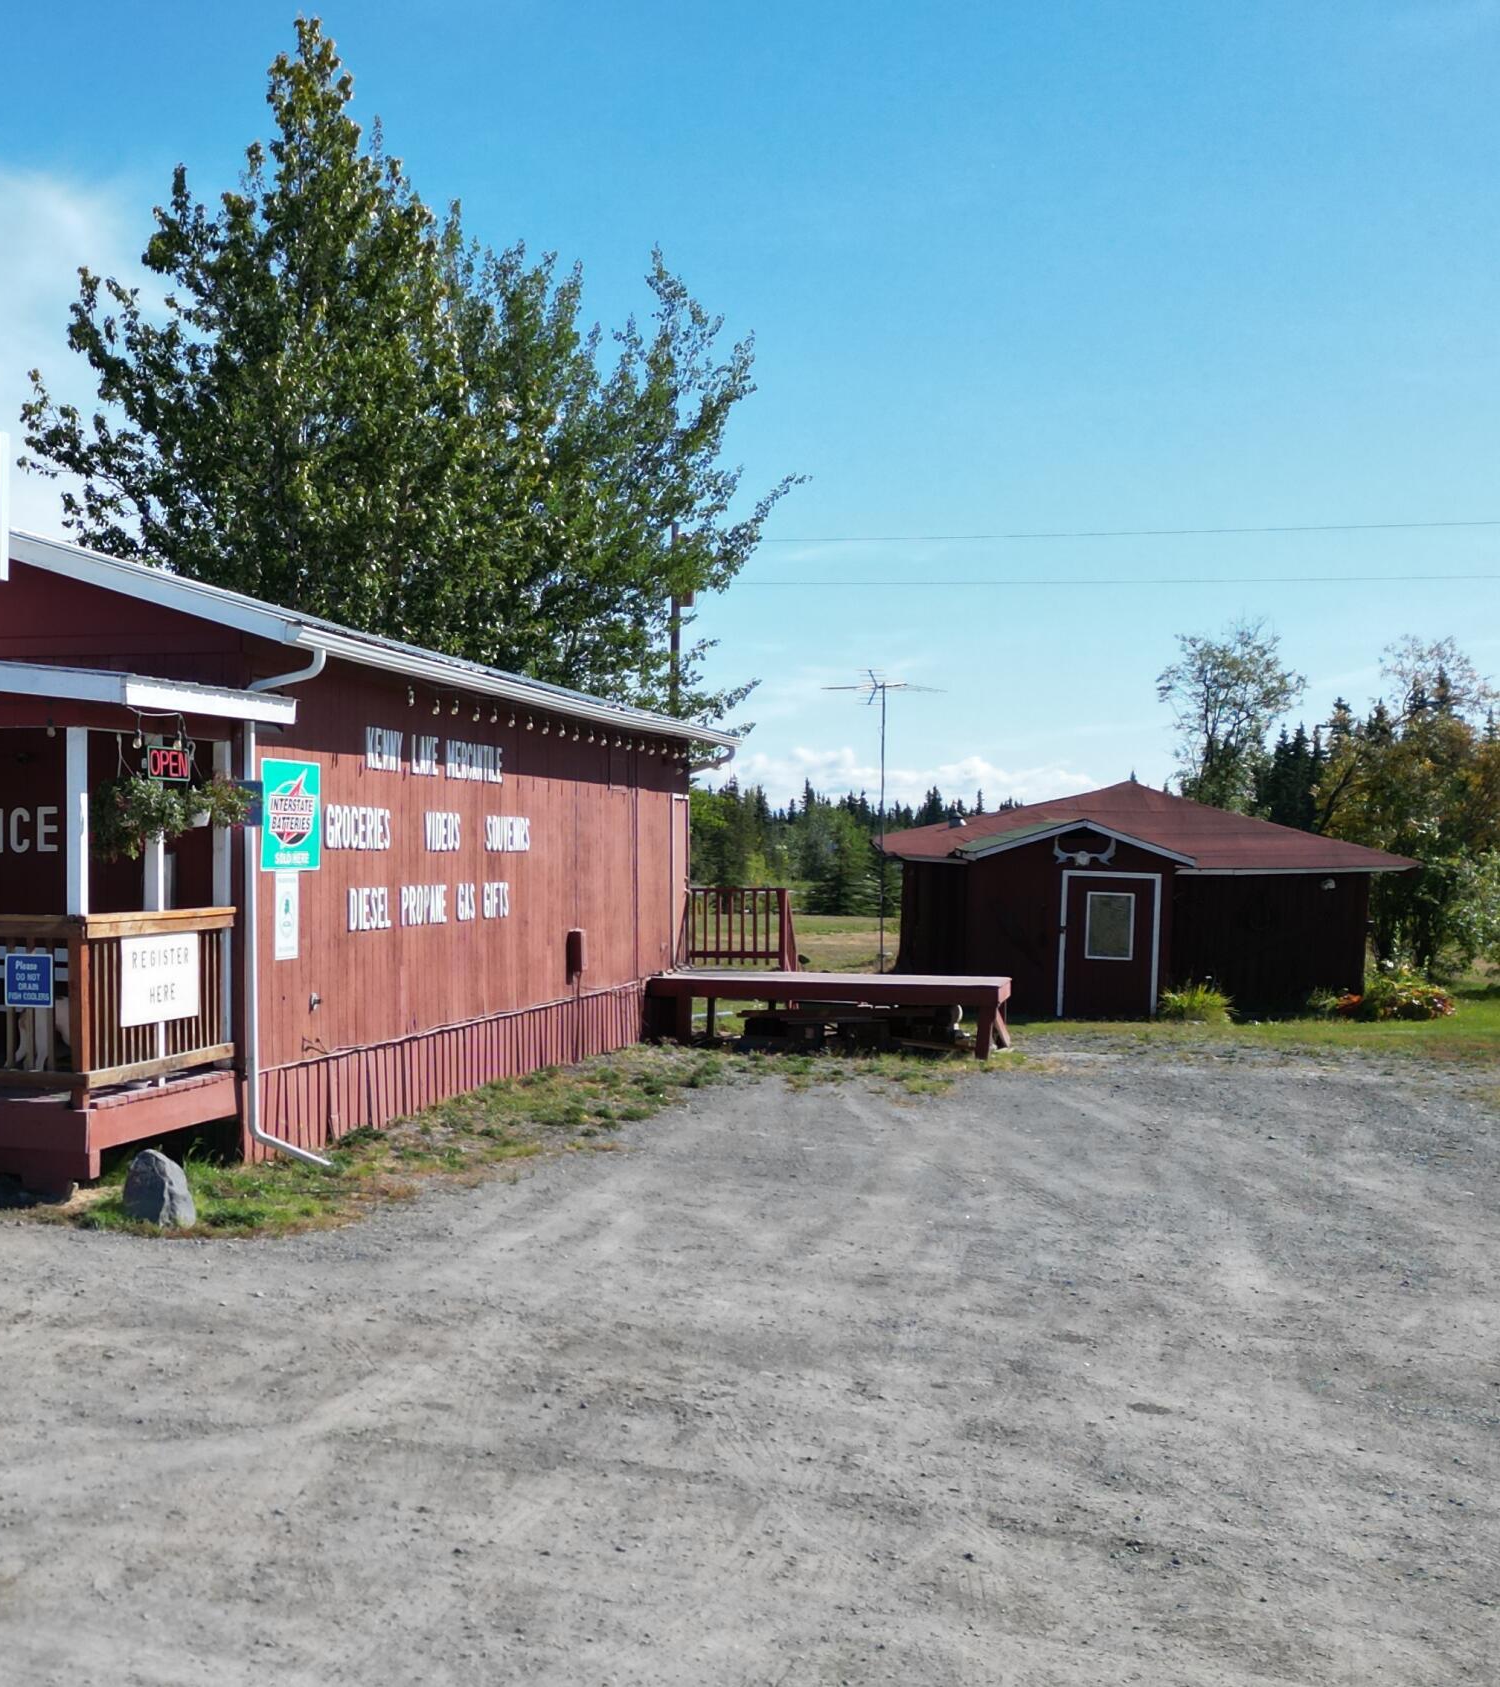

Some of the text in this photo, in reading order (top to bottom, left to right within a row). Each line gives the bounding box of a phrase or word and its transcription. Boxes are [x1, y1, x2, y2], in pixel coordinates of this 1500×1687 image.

[150, 749, 188, 777] OPEN
[366, 726, 503, 783] KENNY LAKE MERCANTILE
[271, 797, 313, 812] INTERSTATE
[272, 816, 311, 830] BATTERIES
[325, 804, 530, 851] GROCERIES VIDEOS SOUVENIRS
[274, 851, 310, 865] SOLD HERE
[349, 882, 509, 931] DIESEL PROPANE GAS GIFTS
[15, 960, 38, 970] Please
[132, 946, 189, 969] REGISTER
[27, 973, 40, 981] NOT
[150, 983, 175, 1004] HERE
